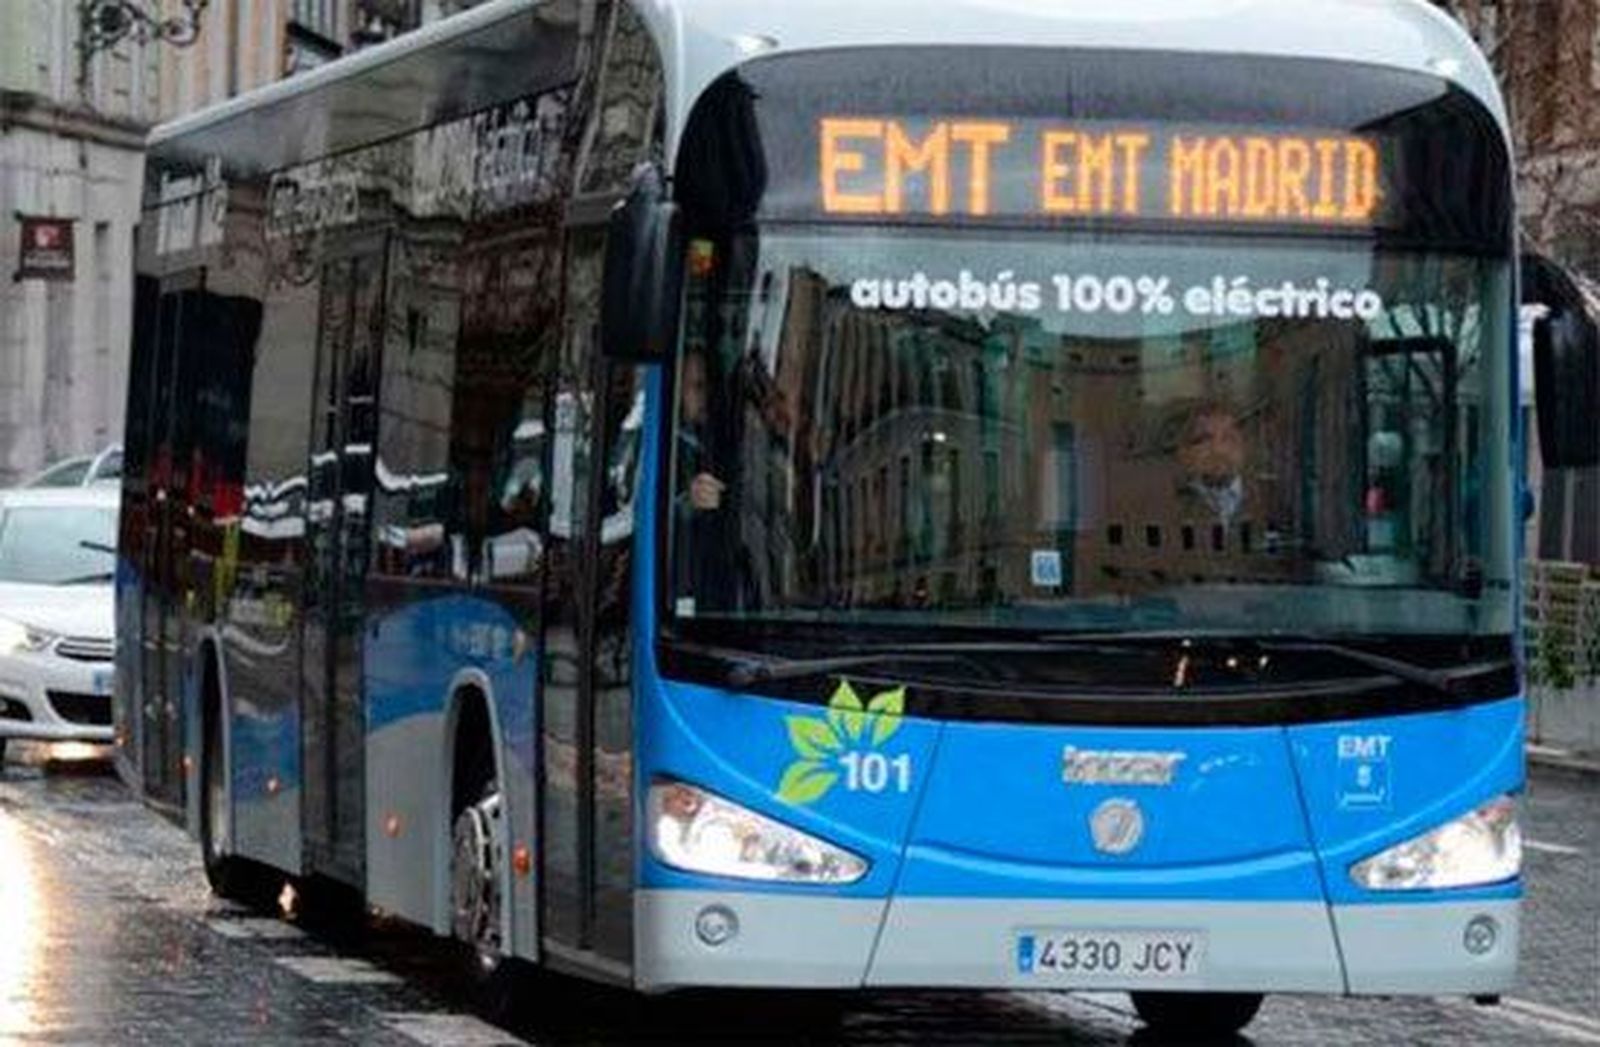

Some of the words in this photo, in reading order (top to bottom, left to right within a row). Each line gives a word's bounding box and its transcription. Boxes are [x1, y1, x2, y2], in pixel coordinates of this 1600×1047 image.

[820, 118, 1010, 216] EMT
[1041, 130, 1150, 215] EMT
[1170, 135, 1379, 222] MADRID
[851, 270, 1042, 310] autobús
[1052, 273, 1174, 315] 100%
[1184, 275, 1382, 319] eléctrico
[1338, 734, 1392, 758] EMT
[840, 751, 909, 793] 101
[1040, 940, 1121, 971] 4330
[1133, 942, 1192, 972] JCY
